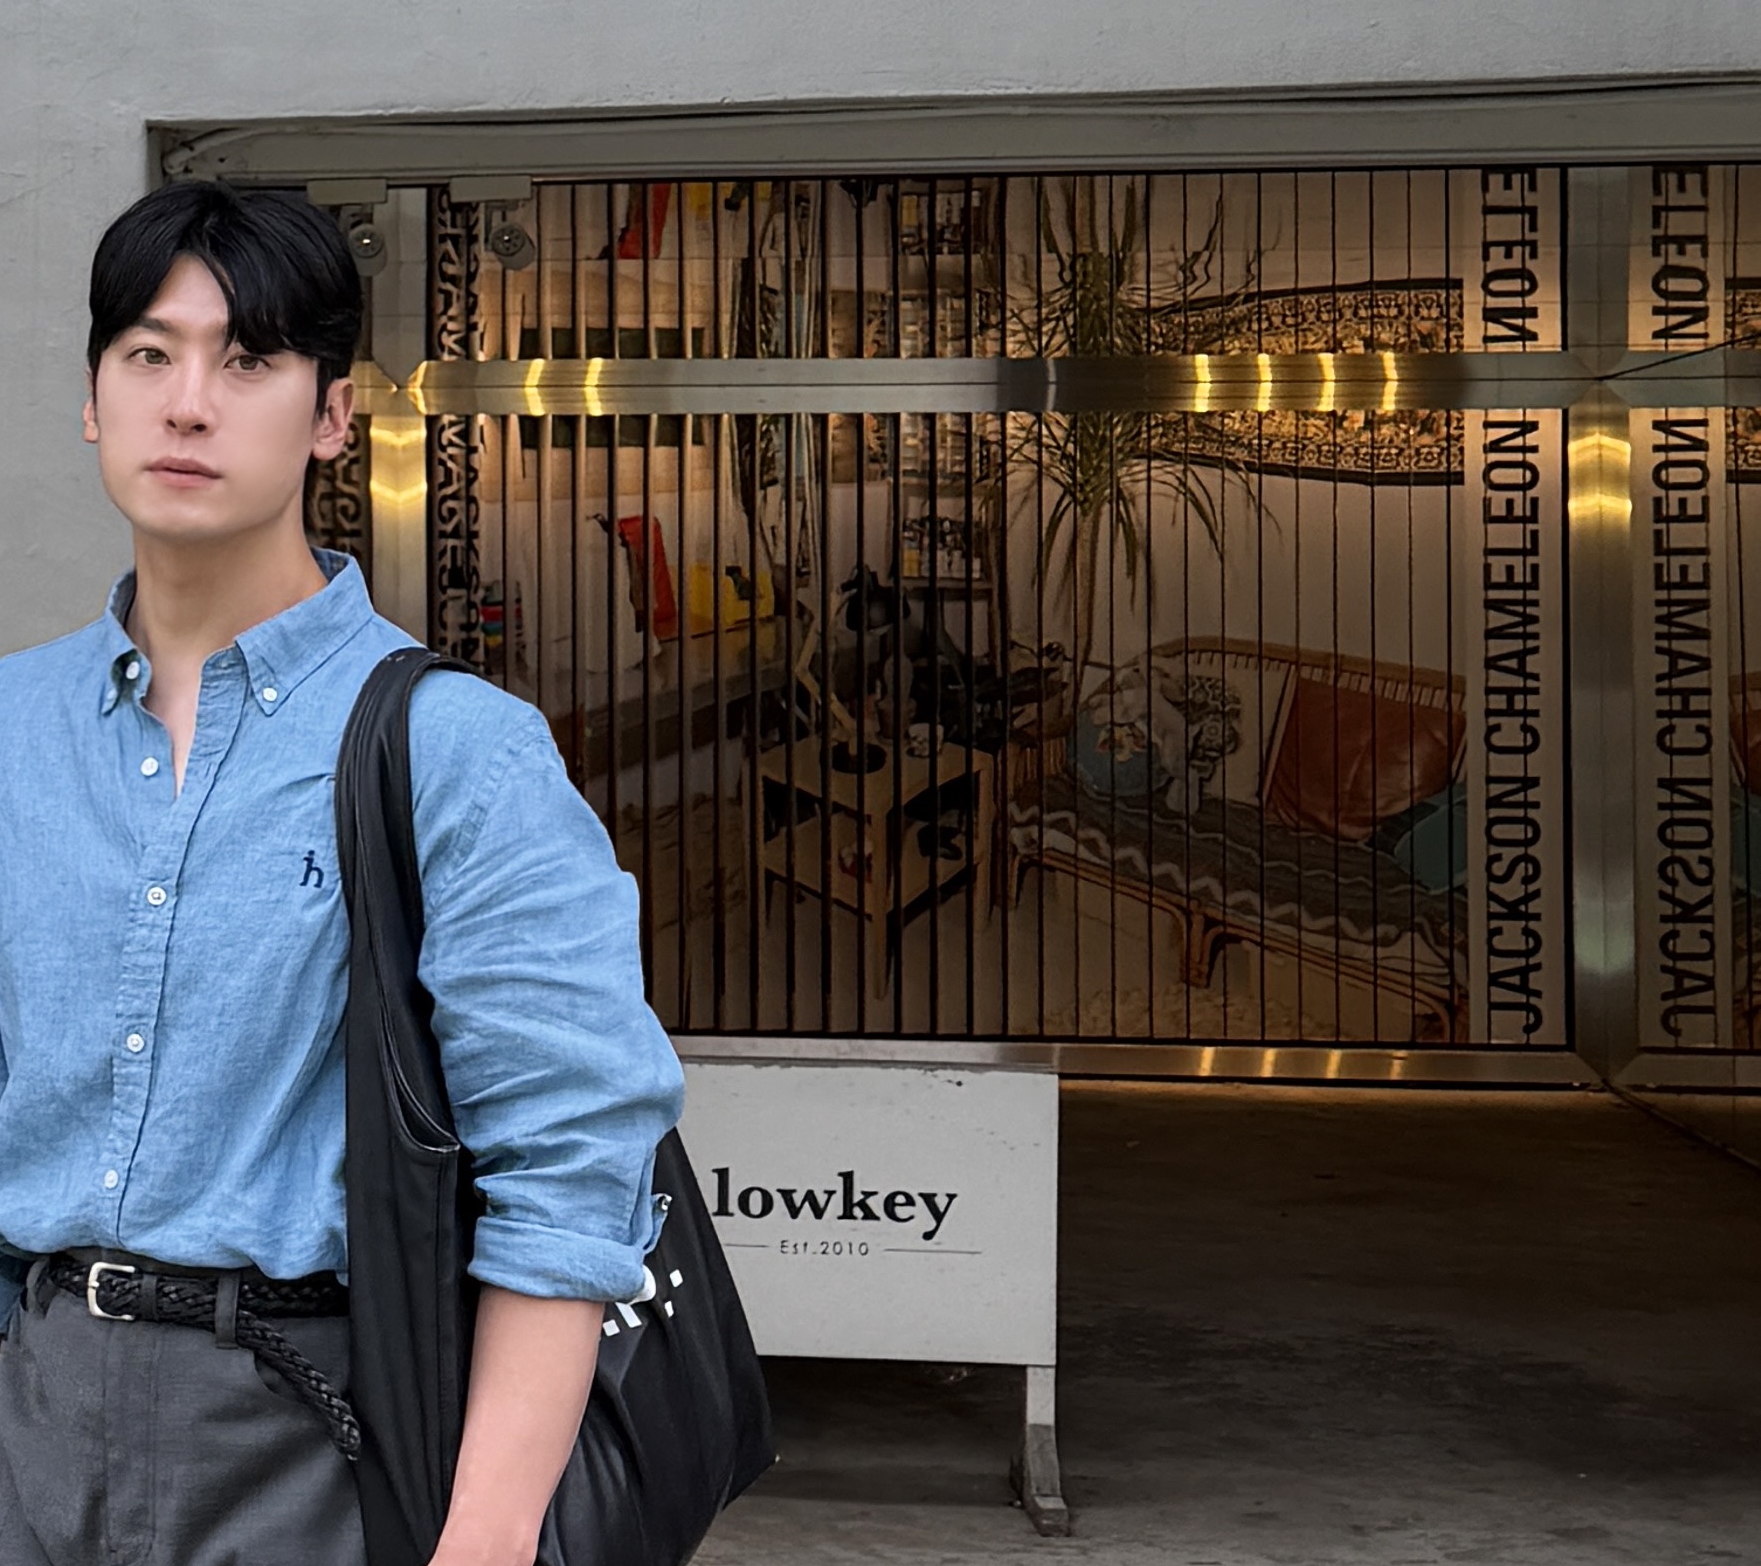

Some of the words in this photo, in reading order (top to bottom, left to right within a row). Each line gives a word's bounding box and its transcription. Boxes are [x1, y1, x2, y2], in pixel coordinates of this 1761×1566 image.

[1482, 419, 1541, 756] CHAMELEON
[1485, 776, 1543, 1035] JACKSON
[712, 1167, 958, 1241] lowkey
[779, 1239, 870, 1257] Est.2010
